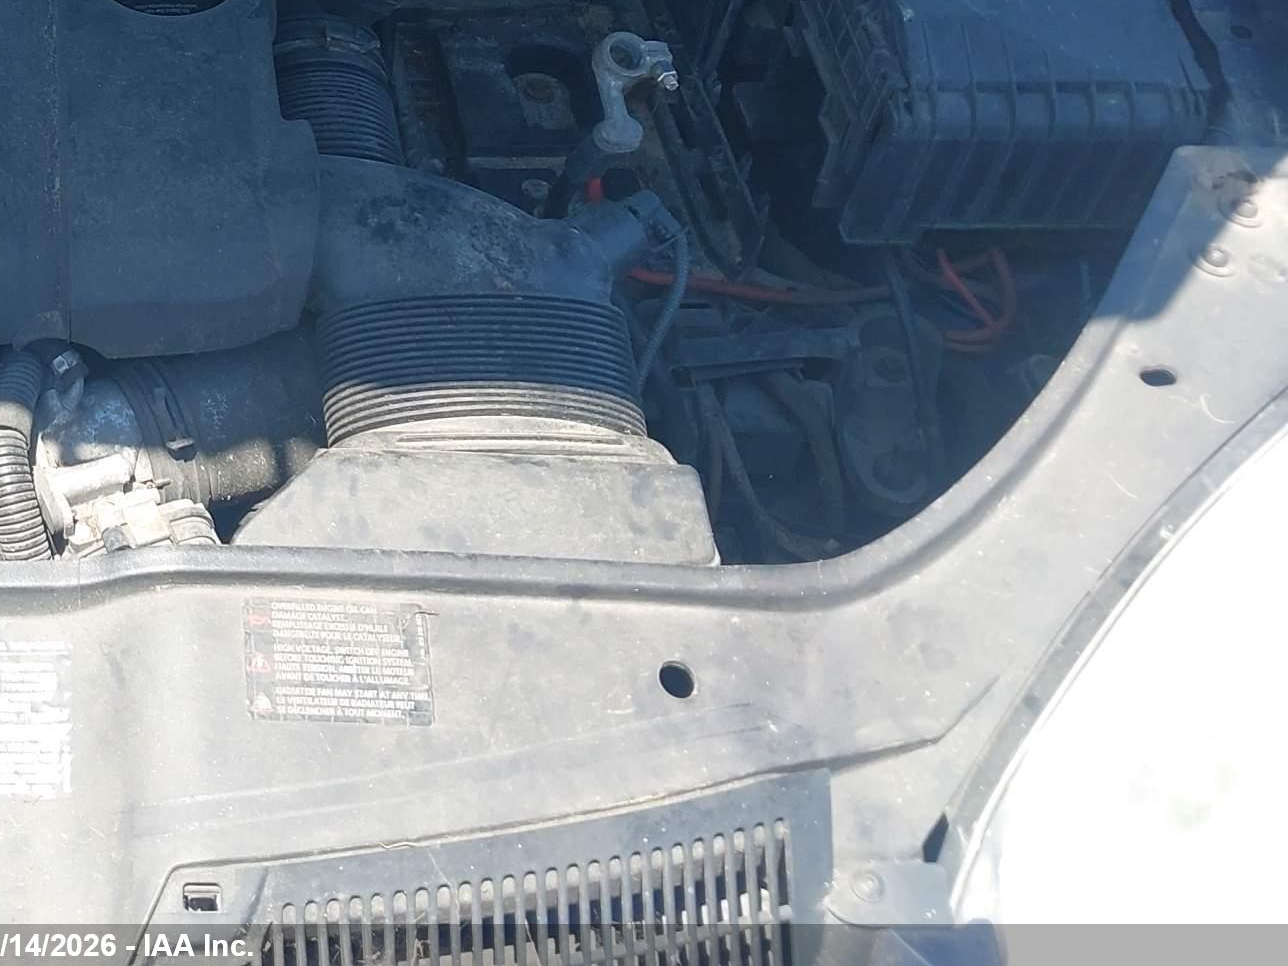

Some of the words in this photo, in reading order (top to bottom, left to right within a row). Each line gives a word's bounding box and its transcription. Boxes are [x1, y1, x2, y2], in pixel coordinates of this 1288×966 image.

[272, 611, 307, 620] DAMAGE
[354, 689, 377, 698] START
[345, 708, 364, 717] TOUT
